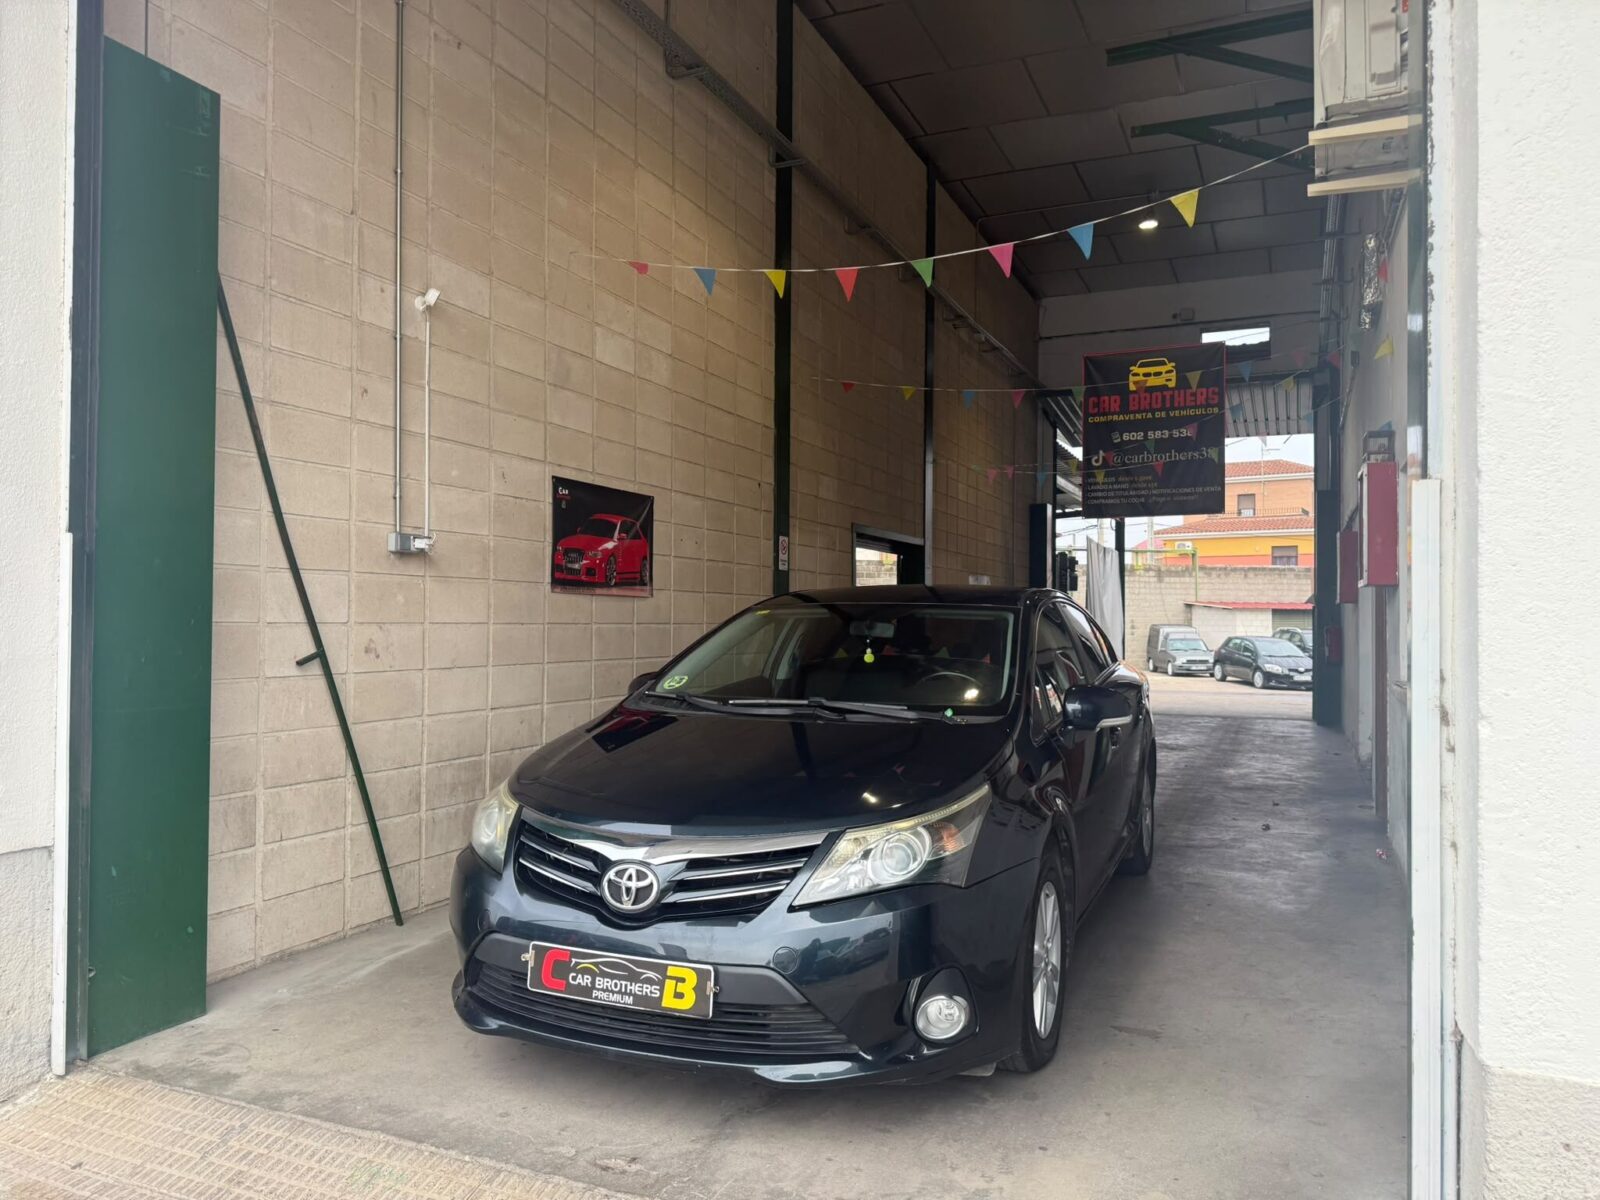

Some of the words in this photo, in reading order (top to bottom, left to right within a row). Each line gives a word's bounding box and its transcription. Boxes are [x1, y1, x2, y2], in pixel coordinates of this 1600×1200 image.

[1088, 395, 1121, 414] CAR
[1129, 388, 1218, 410] BROTHERS
[1088, 412, 1153, 423] COMPRAVENTA
[1170, 407, 1219, 417] VEHÍCULOS
[1122, 431, 1144, 441] 602
[1147, 430, 1169, 439] 583
[541, 948, 570, 992] C
[569, 973, 591, 987] CAR
[595, 977, 660, 997] BROTHERS
[592, 990, 633, 1005] PREMIUM
